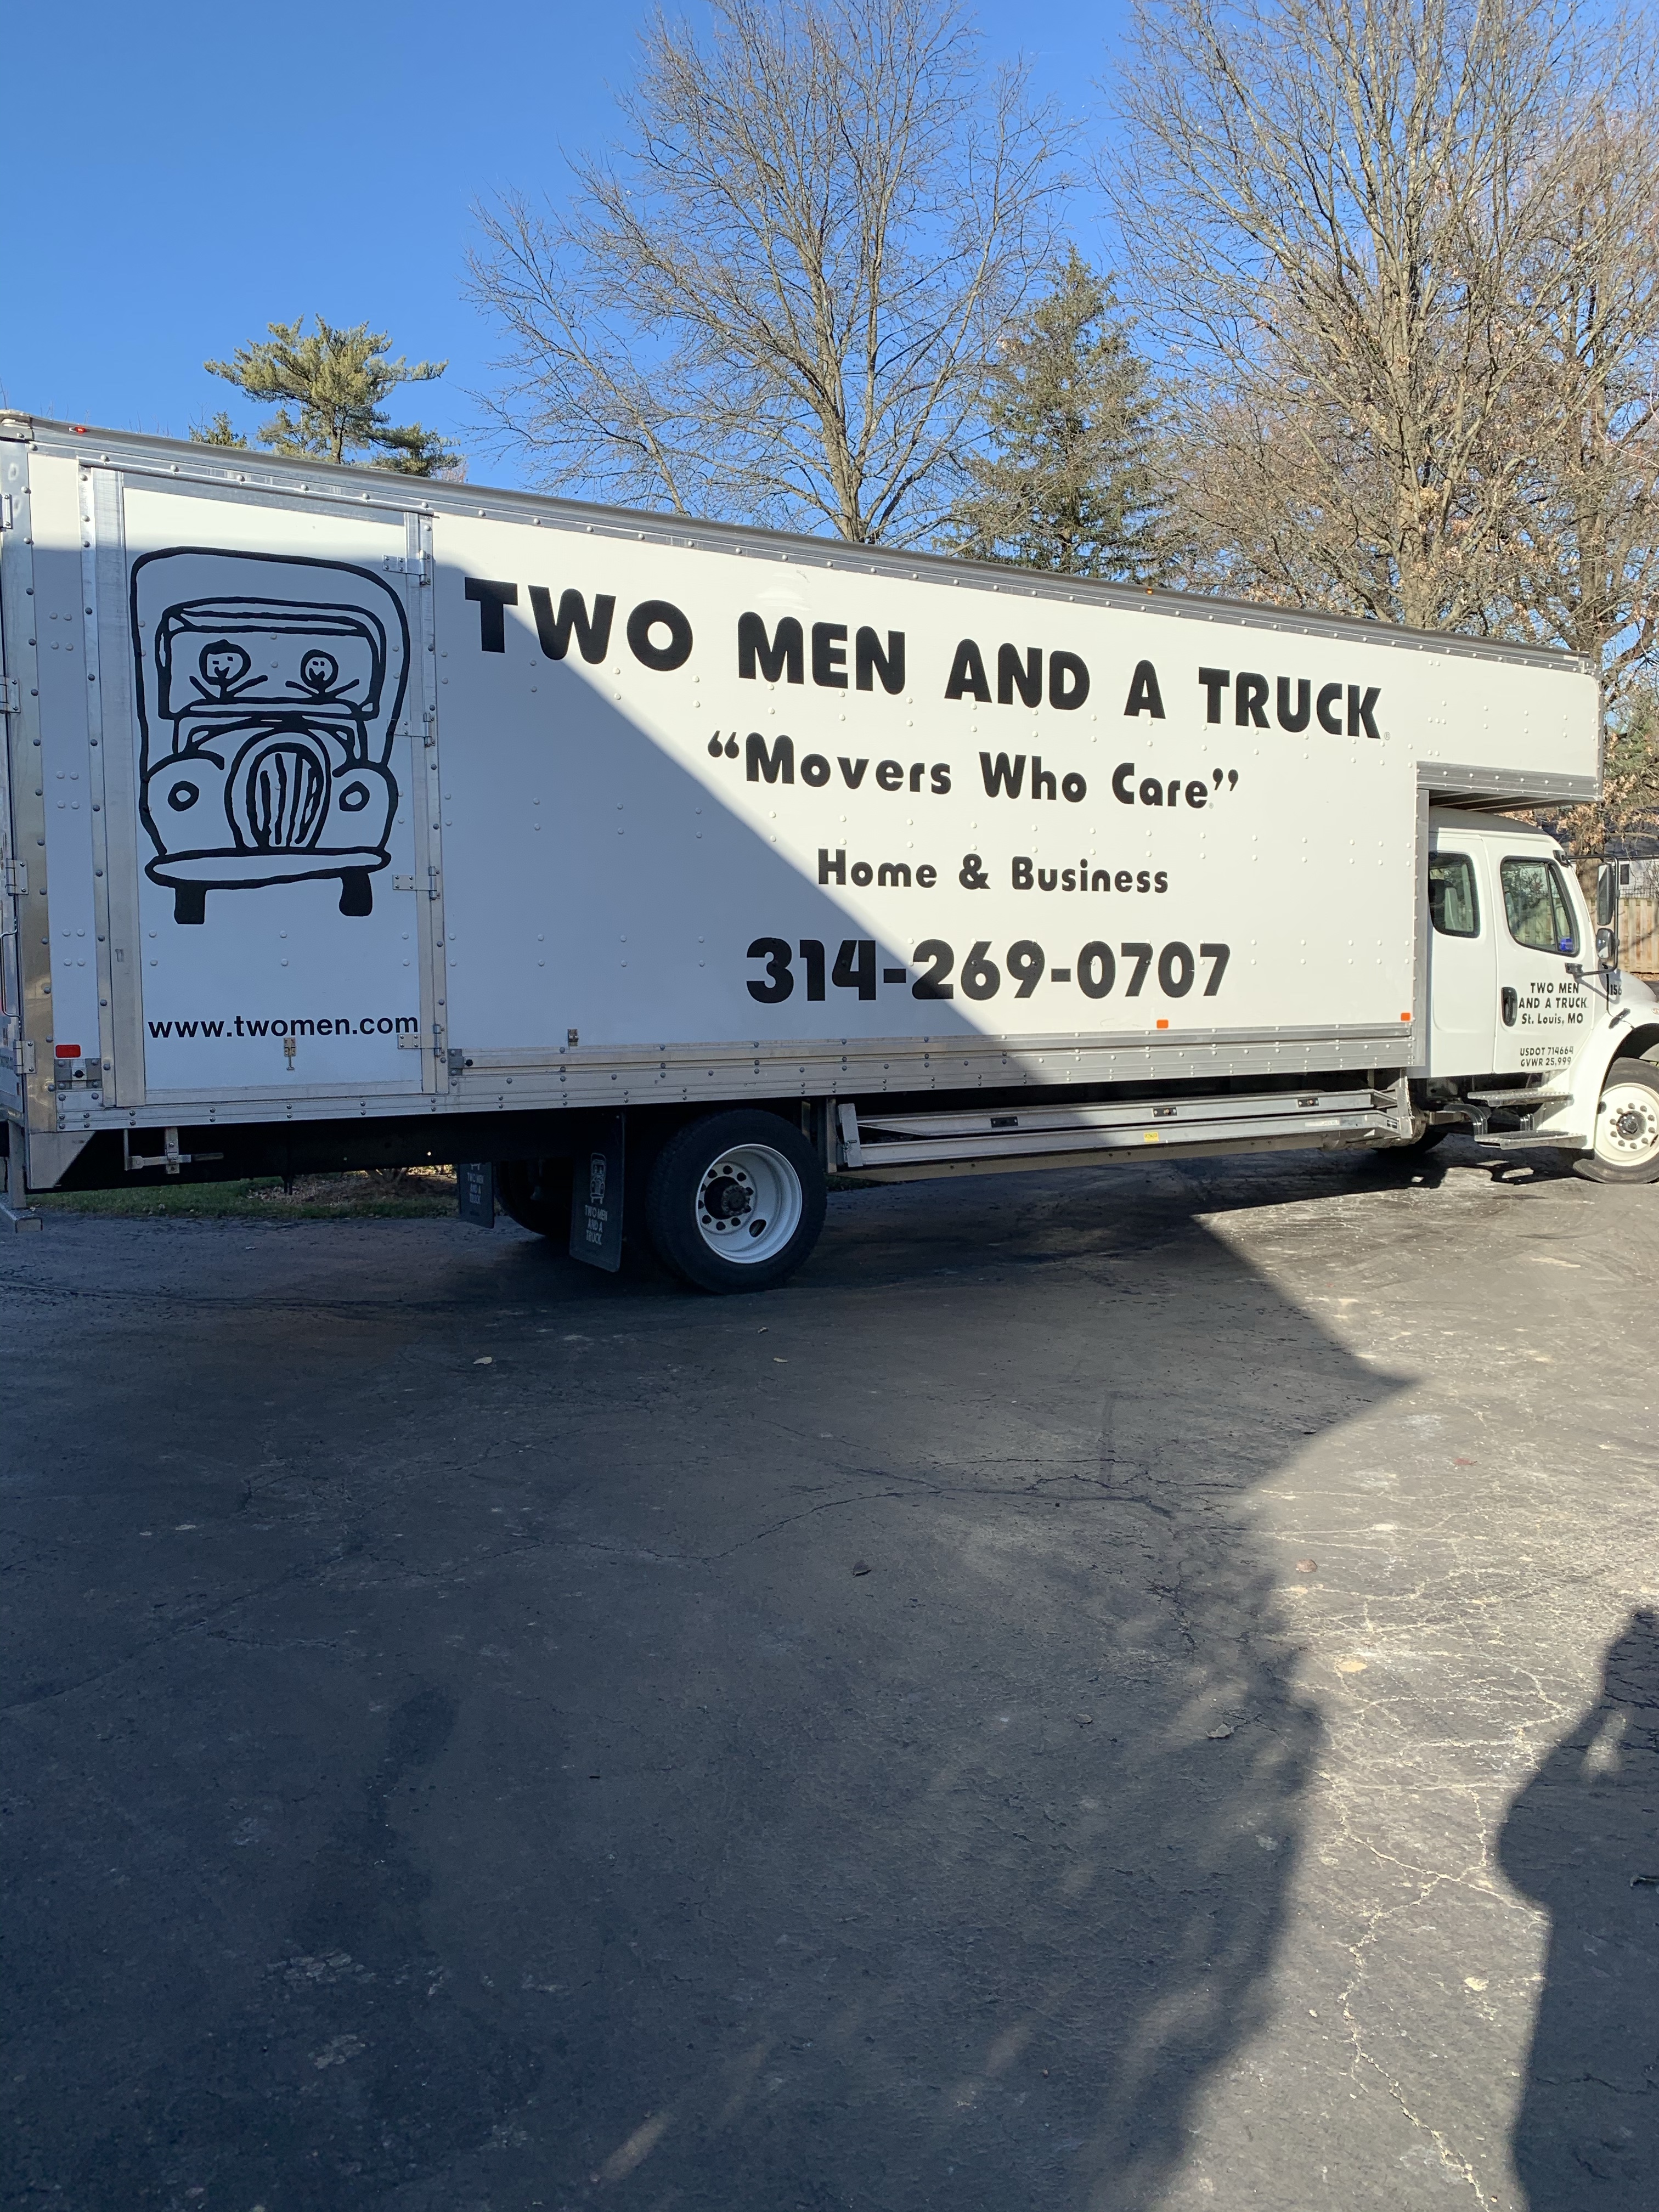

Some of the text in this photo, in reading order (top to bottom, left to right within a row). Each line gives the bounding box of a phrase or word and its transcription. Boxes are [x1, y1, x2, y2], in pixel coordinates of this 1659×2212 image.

[465, 577, 1381, 739] TWO MEN AND A TRUCK
[979, 752, 1087, 803] Who
[818, 848, 1168, 893] Home & Business
[746, 937, 1230, 1004] 314-269-0707
[1531, 983, 1579, 994] TWO MEN
[1610, 984, 1622, 996] 156
[1519, 997, 1587, 1008] AND A TRUCK
[1521, 1013, 1583, 1026] St. Louis, MO
[148, 1015, 418, 1039] www.twomen.com
[1520, 1046, 1573, 1056] USDOT 714664
[1521, 1057, 1572, 1067] GVWR 25,999
[585, 1205, 597, 1218] TWO
[599, 1221, 603, 1233] A
